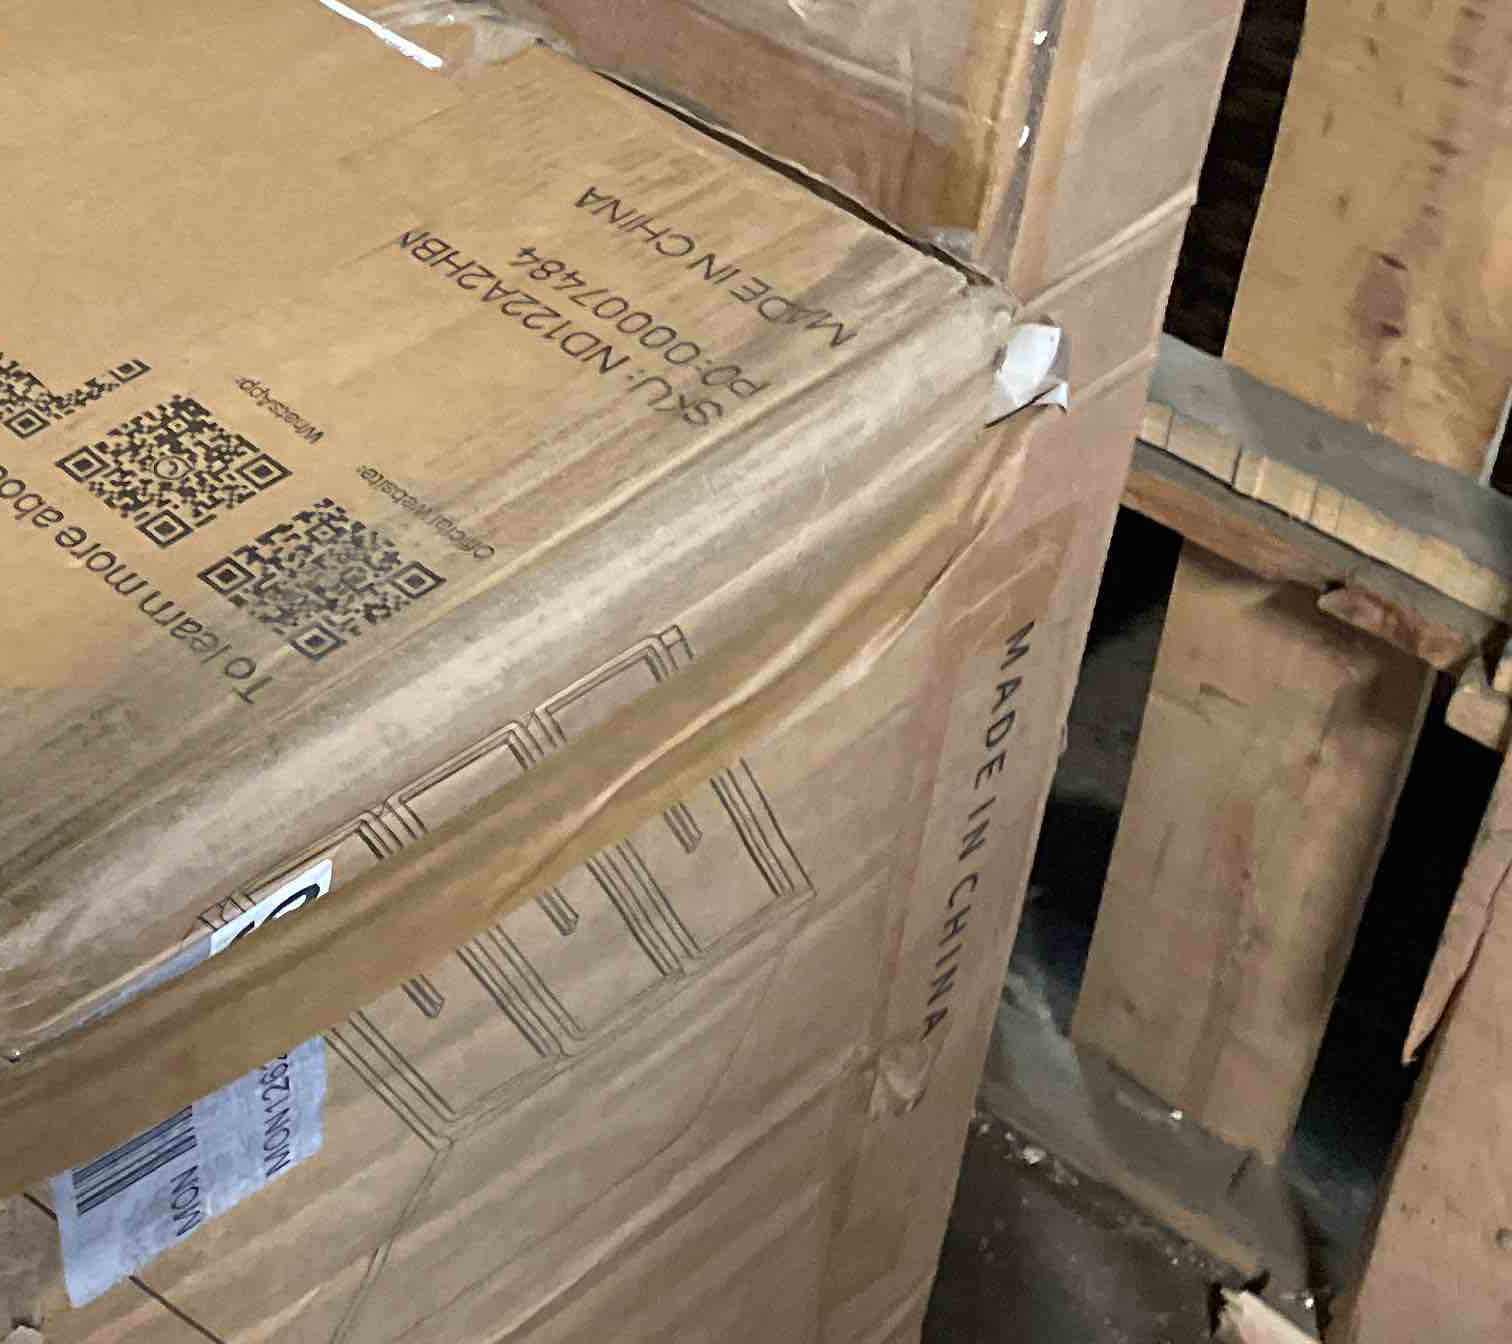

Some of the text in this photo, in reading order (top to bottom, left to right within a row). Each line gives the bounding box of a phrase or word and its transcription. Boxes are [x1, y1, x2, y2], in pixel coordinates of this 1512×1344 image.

[575, 186, 857, 348] MADE IN CHINA
[628, 369, 723, 426] SKU:
[55, 526, 148, 596] more
[138, 590, 232, 664] learn
[224, 656, 273, 705] To
[920, 620, 1035, 1041] MADE IN CHINA
